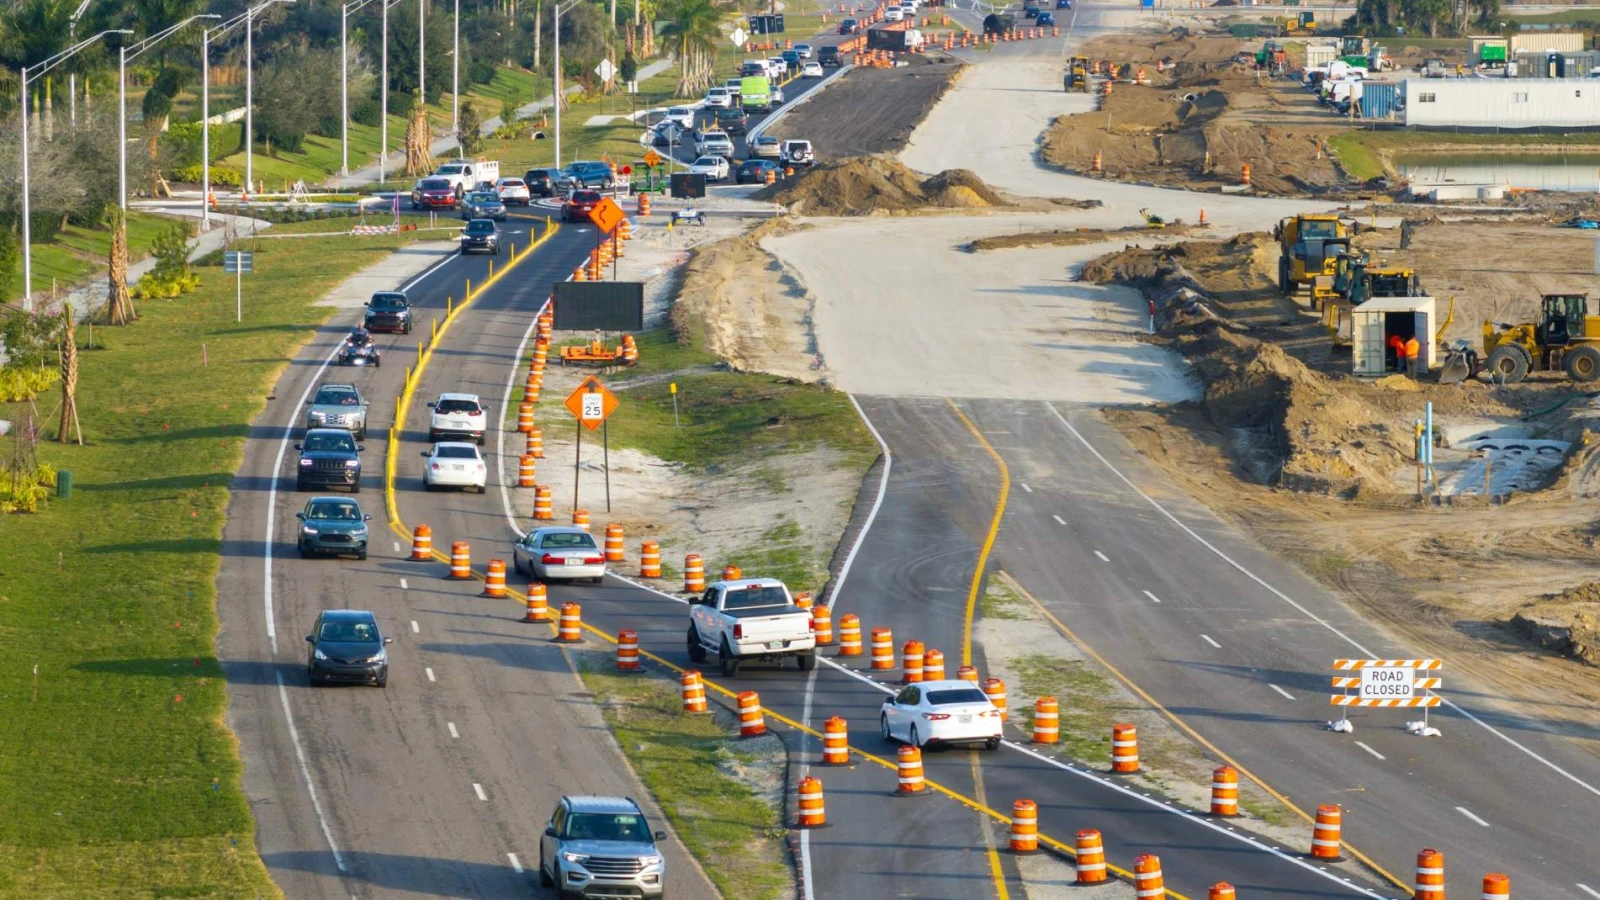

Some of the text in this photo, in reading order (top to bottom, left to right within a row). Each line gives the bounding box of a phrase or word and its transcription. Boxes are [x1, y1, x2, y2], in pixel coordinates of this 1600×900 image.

[585, 406, 601, 416] 25
[1372, 671, 1404, 681] ROAD
[1365, 685, 1410, 695] CLOSED
